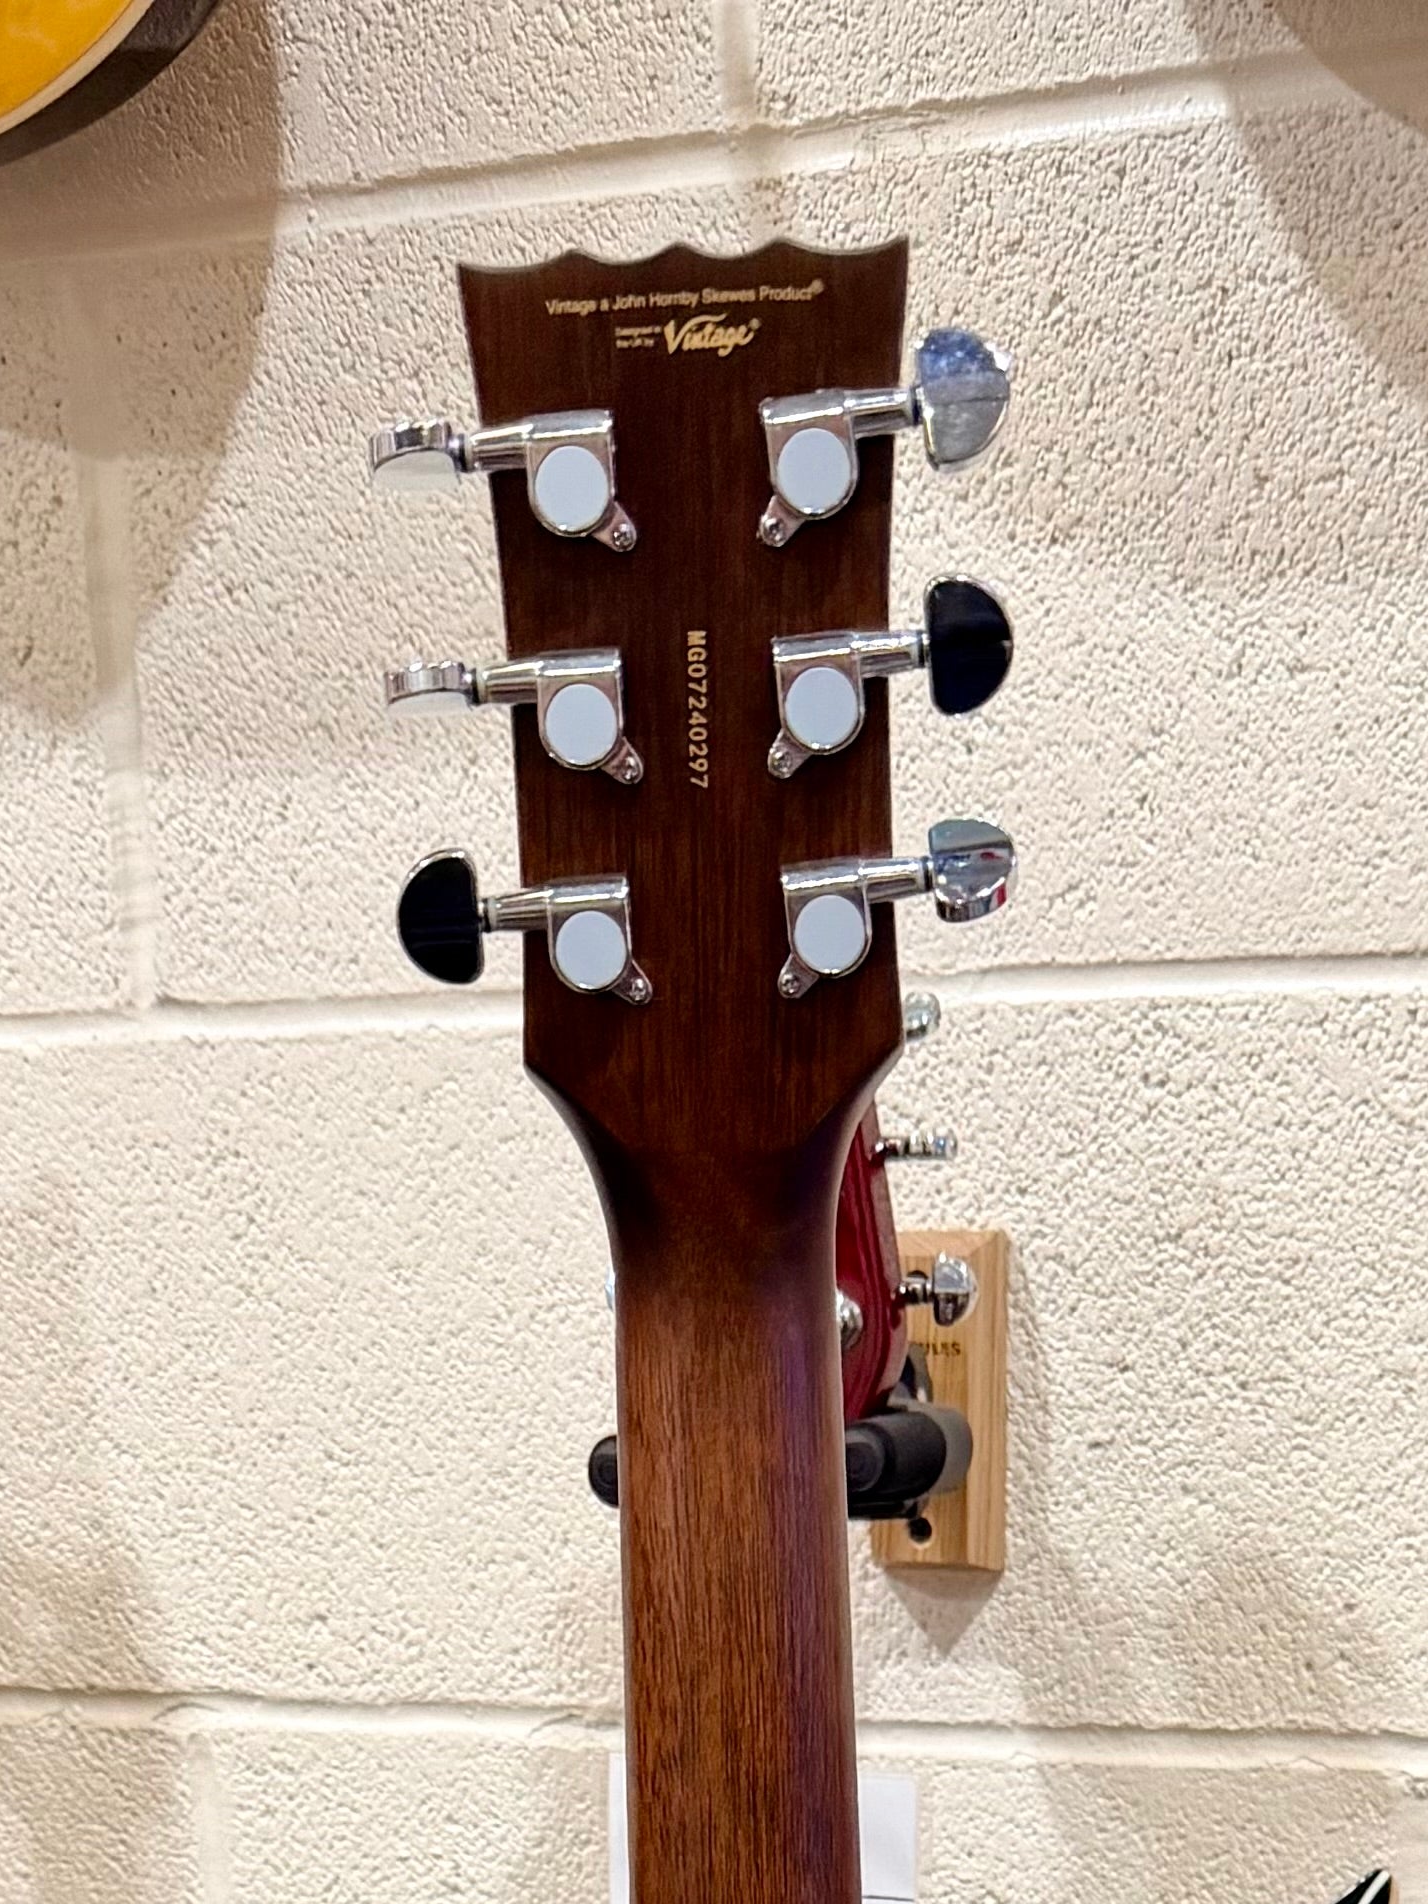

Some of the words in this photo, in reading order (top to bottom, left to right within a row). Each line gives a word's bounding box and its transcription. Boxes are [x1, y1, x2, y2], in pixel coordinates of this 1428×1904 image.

[546, 299, 596, 316] Vintage
[612, 295, 646, 310] John
[649, 291, 699, 308] Hornby
[701, 288, 756, 304] Skewes
[687, 630, 709, 789] MG07240297
